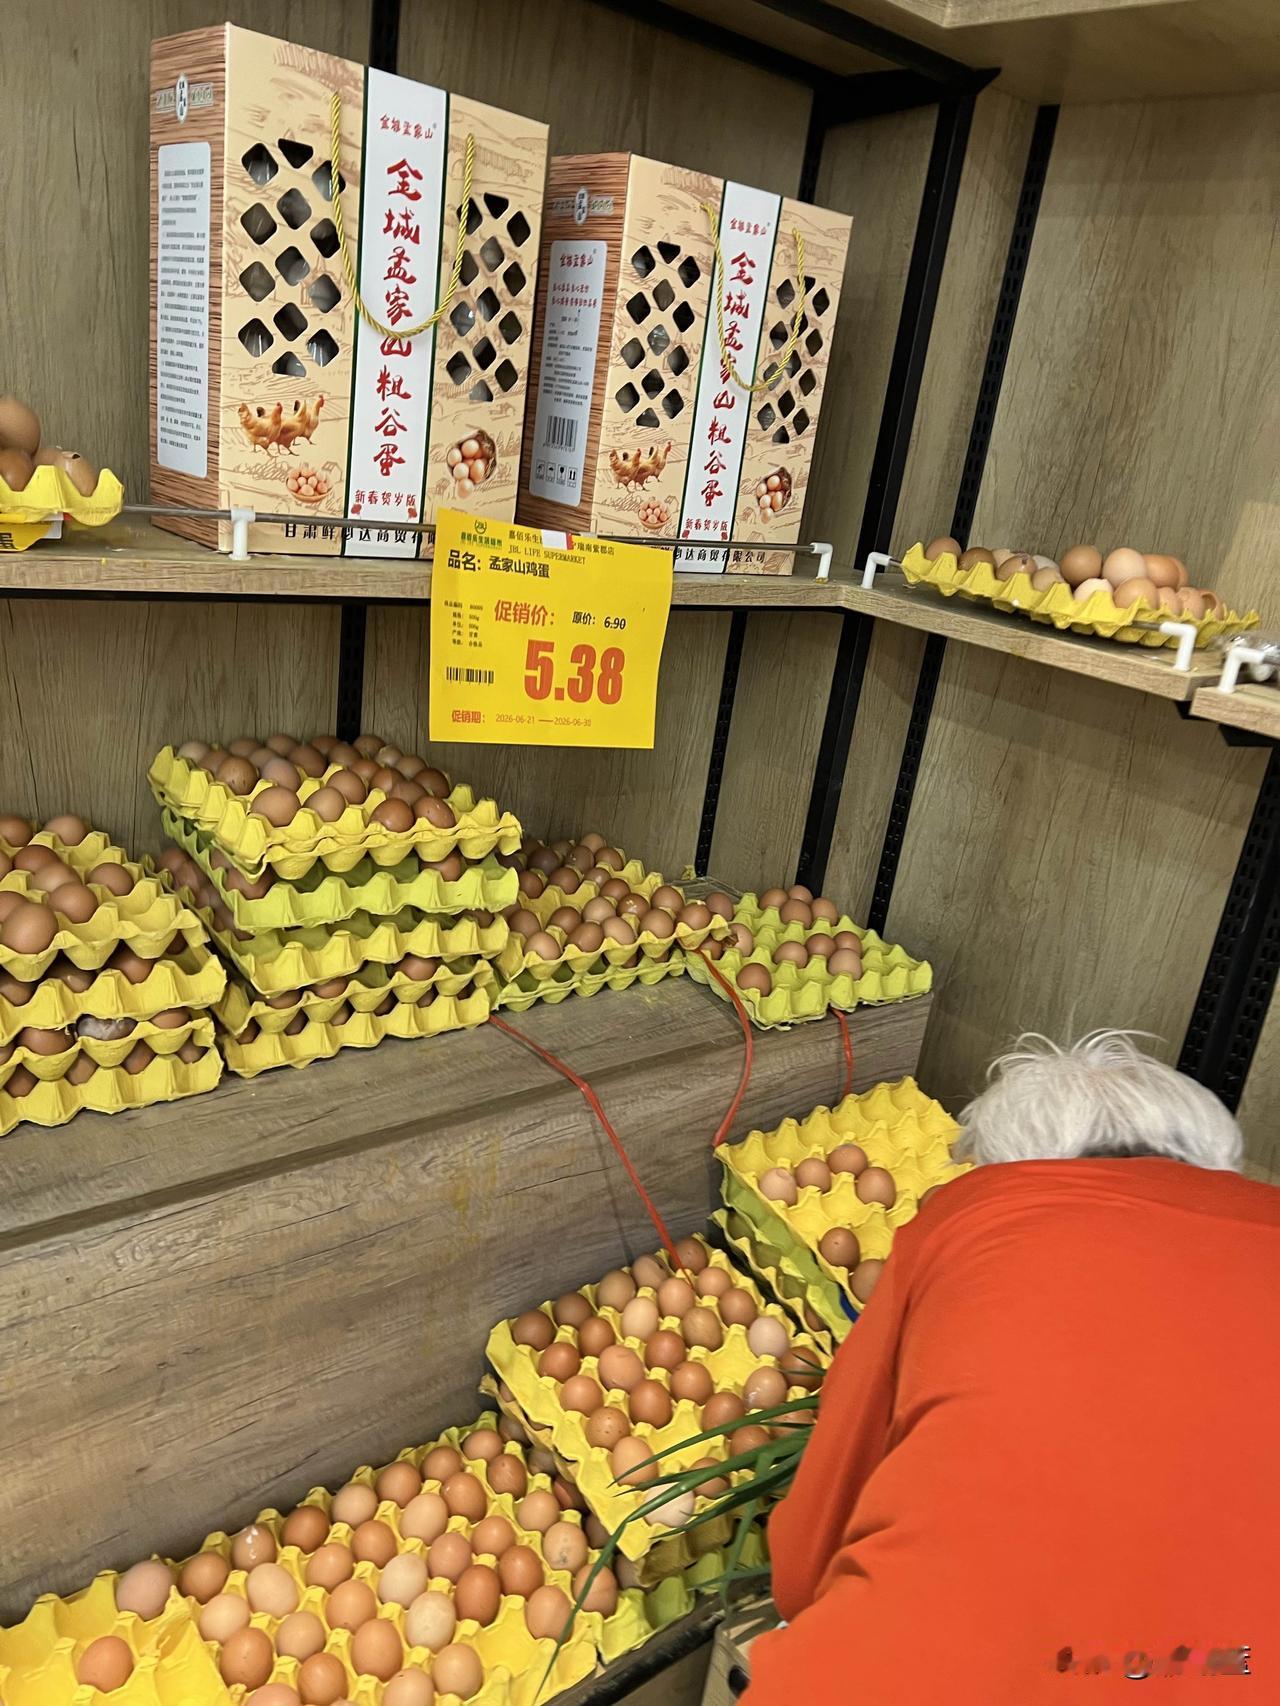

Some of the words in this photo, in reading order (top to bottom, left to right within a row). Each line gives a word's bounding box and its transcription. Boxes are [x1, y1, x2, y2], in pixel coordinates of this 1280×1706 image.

[373, 158, 424, 478] 金城孟家山粗谷蛋
[701, 251, 756, 507] 金城孟家山粗谷蛋
[354, 489, 417, 507] 新春贺岁版
[508, 544, 522, 555] JBL
[525, 547, 542, 558] LIFE
[543, 550, 586, 565] SUPERMARKET
[489, 555, 551, 579] 孟家山鸡蛋
[604, 616, 627, 631] 6.90
[524, 639, 626, 706] 5.38
[496, 713, 535, 725] 2026-06-21
